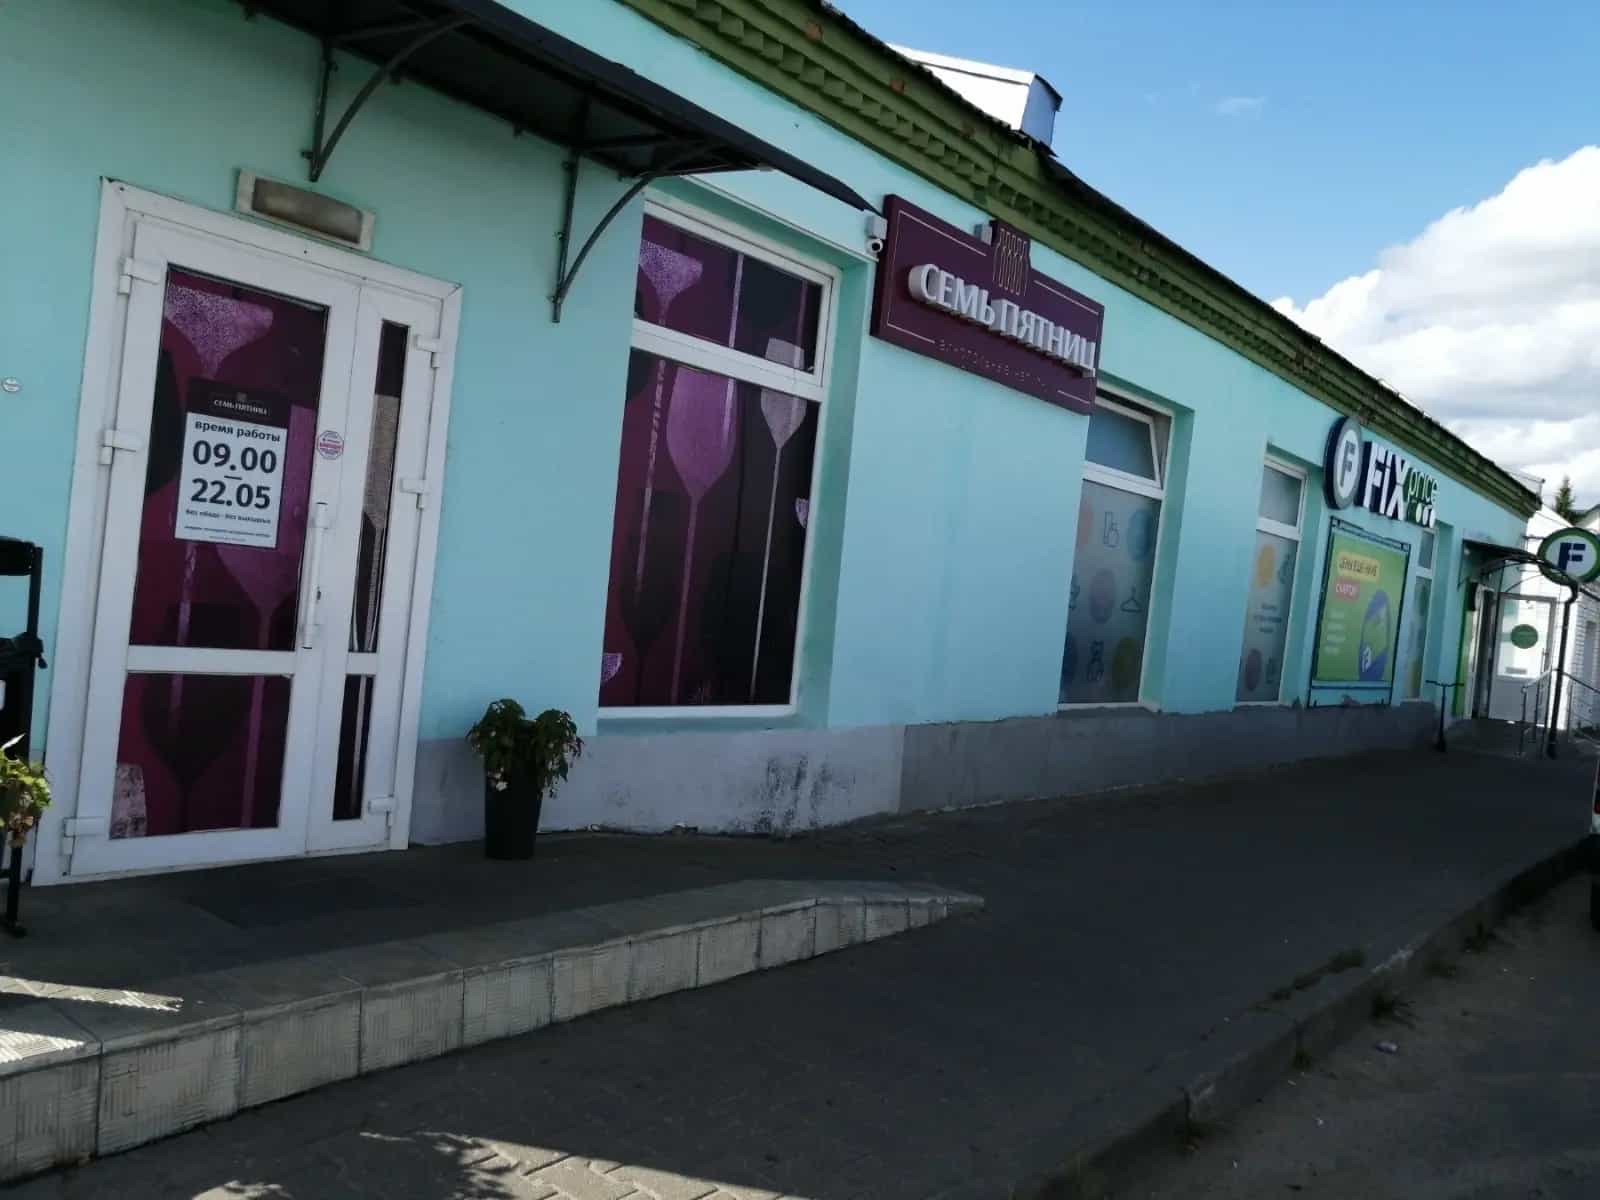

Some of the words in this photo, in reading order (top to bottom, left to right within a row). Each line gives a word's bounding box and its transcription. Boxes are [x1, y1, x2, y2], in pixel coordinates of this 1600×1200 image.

[195, 421, 233, 435] время
[237, 428, 280, 442] работы
[193, 440, 277, 473] 09.00
[191, 478, 270, 509] 22.05
[1557, 542, 1586, 570] F
